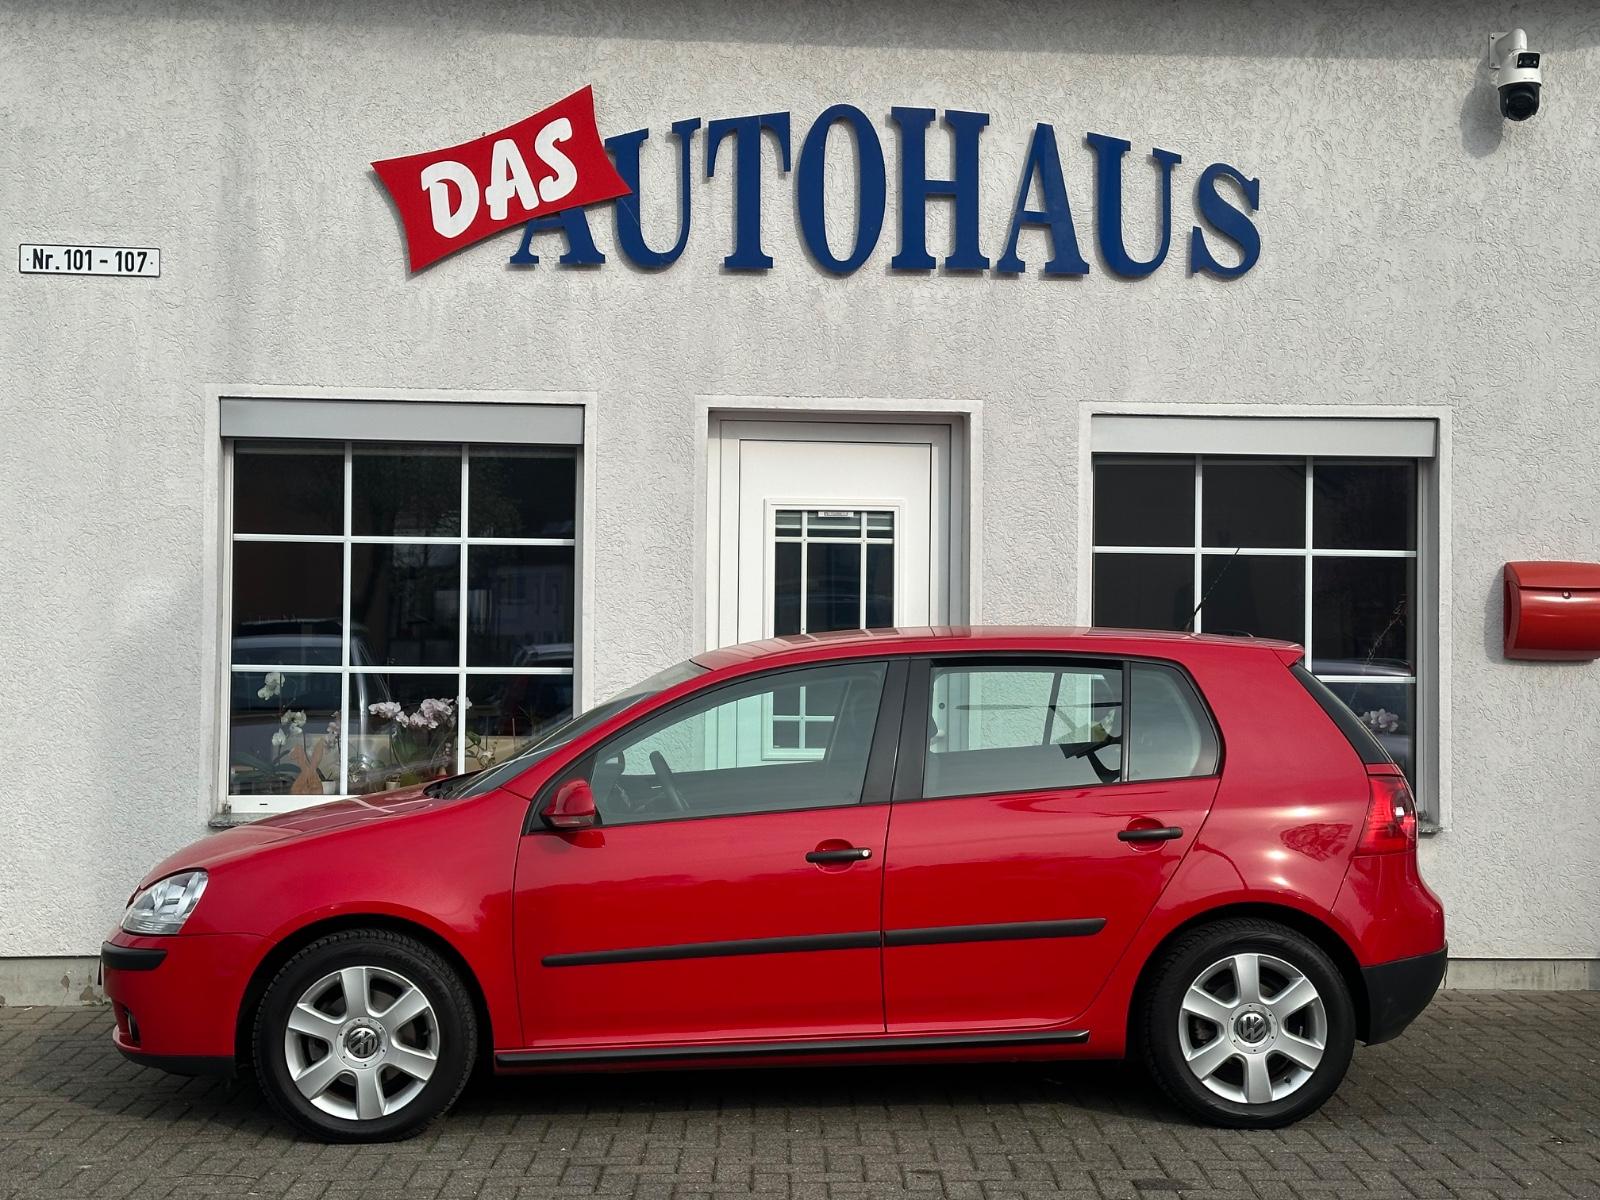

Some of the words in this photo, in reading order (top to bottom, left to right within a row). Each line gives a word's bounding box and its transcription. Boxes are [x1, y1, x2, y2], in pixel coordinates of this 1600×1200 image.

[421, 117, 578, 239] DAS
[511, 105, 1260, 277] AUTOHAUS
[33, 249, 60, 270] Nr.
[64, 249, 92, 271] 101
[115, 251, 148, 272] 107
